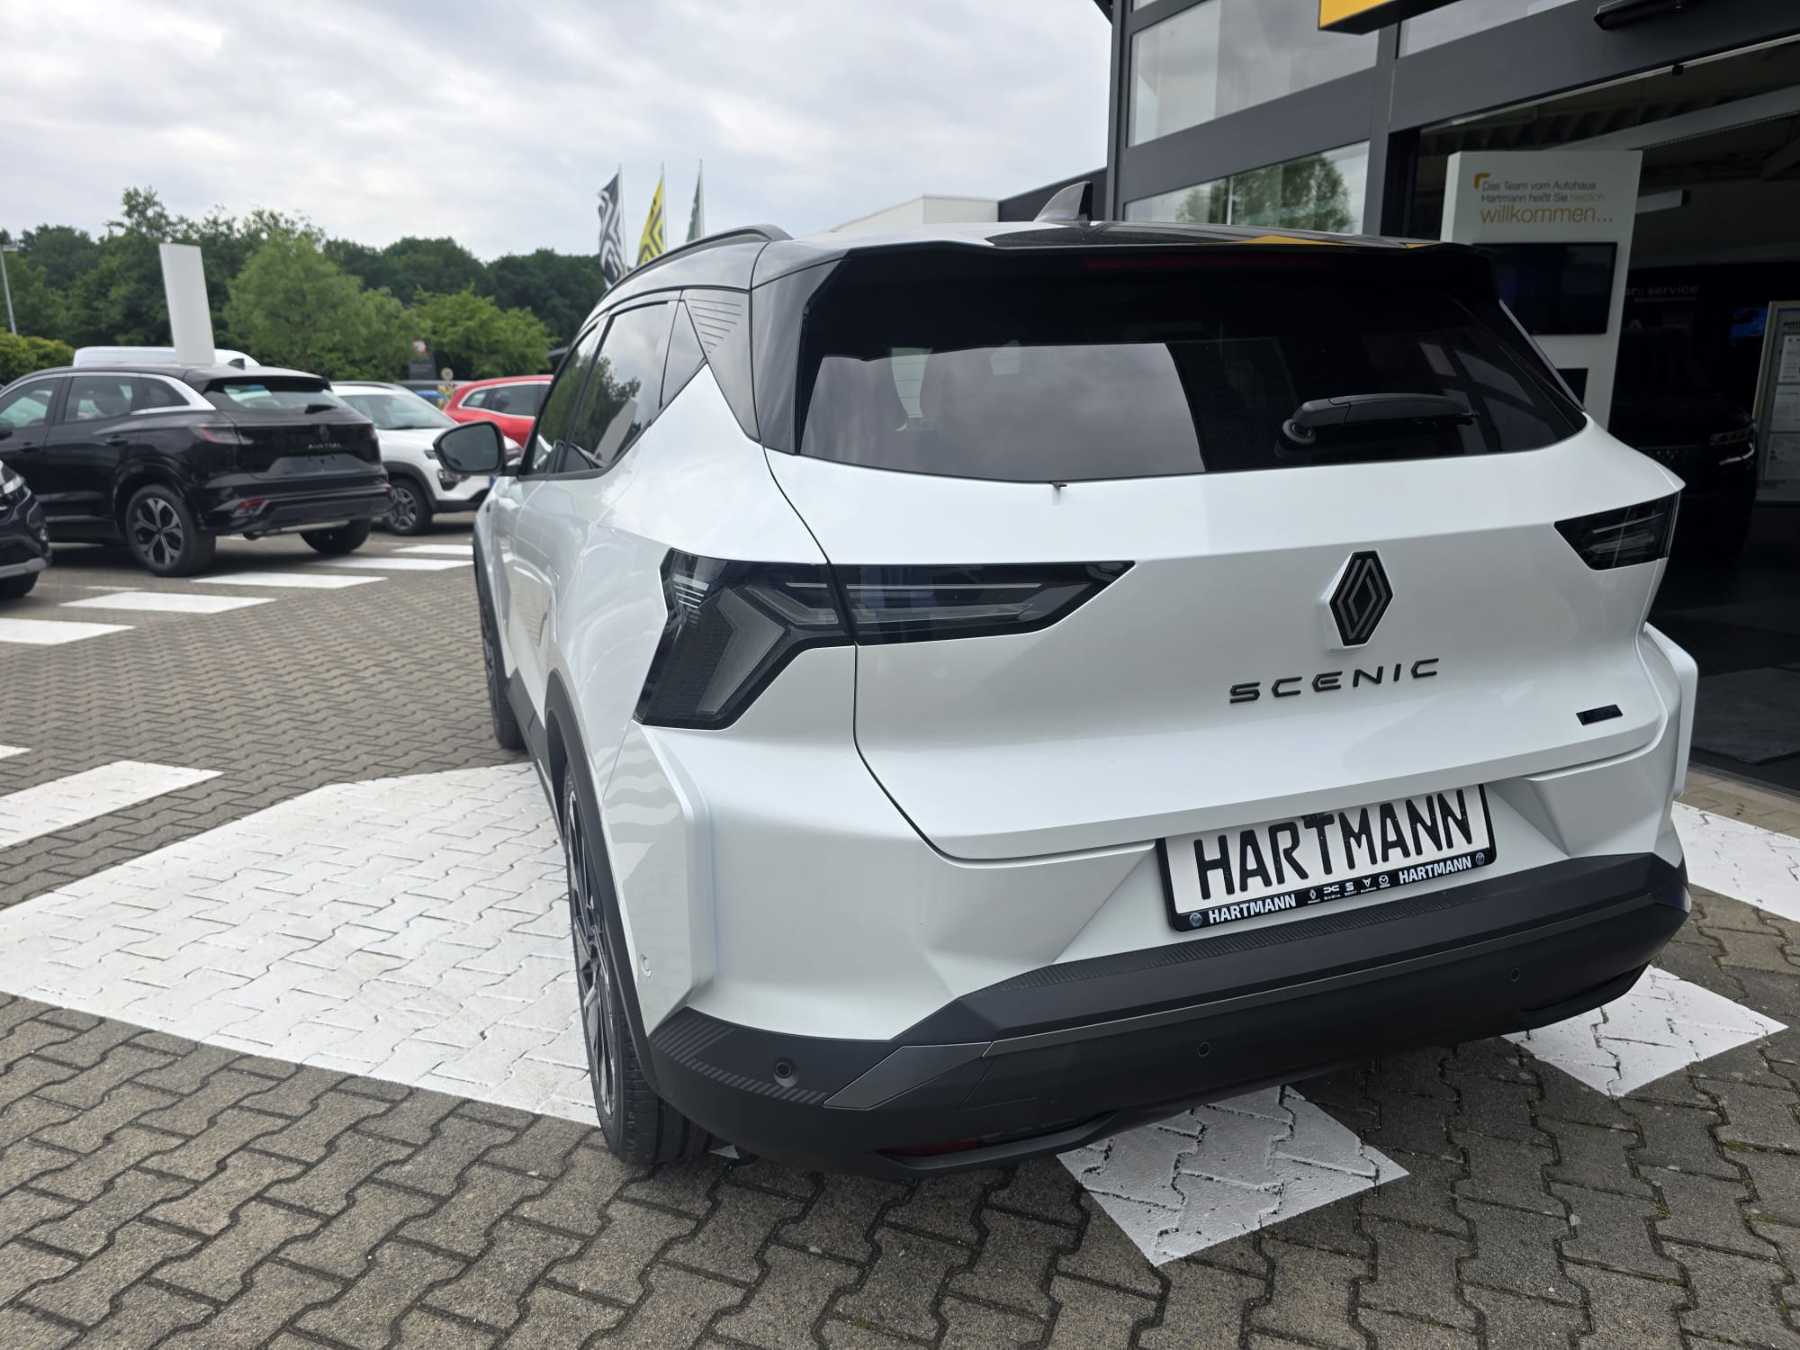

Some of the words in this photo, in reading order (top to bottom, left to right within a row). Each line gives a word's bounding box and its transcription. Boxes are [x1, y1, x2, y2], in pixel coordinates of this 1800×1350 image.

[1230, 658, 1439, 704] SCENIC
[1193, 789, 1472, 900] HARTMANN
[1208, 893, 1296, 924] HARTMANN
[1399, 855, 1472, 885] HARTMANN
